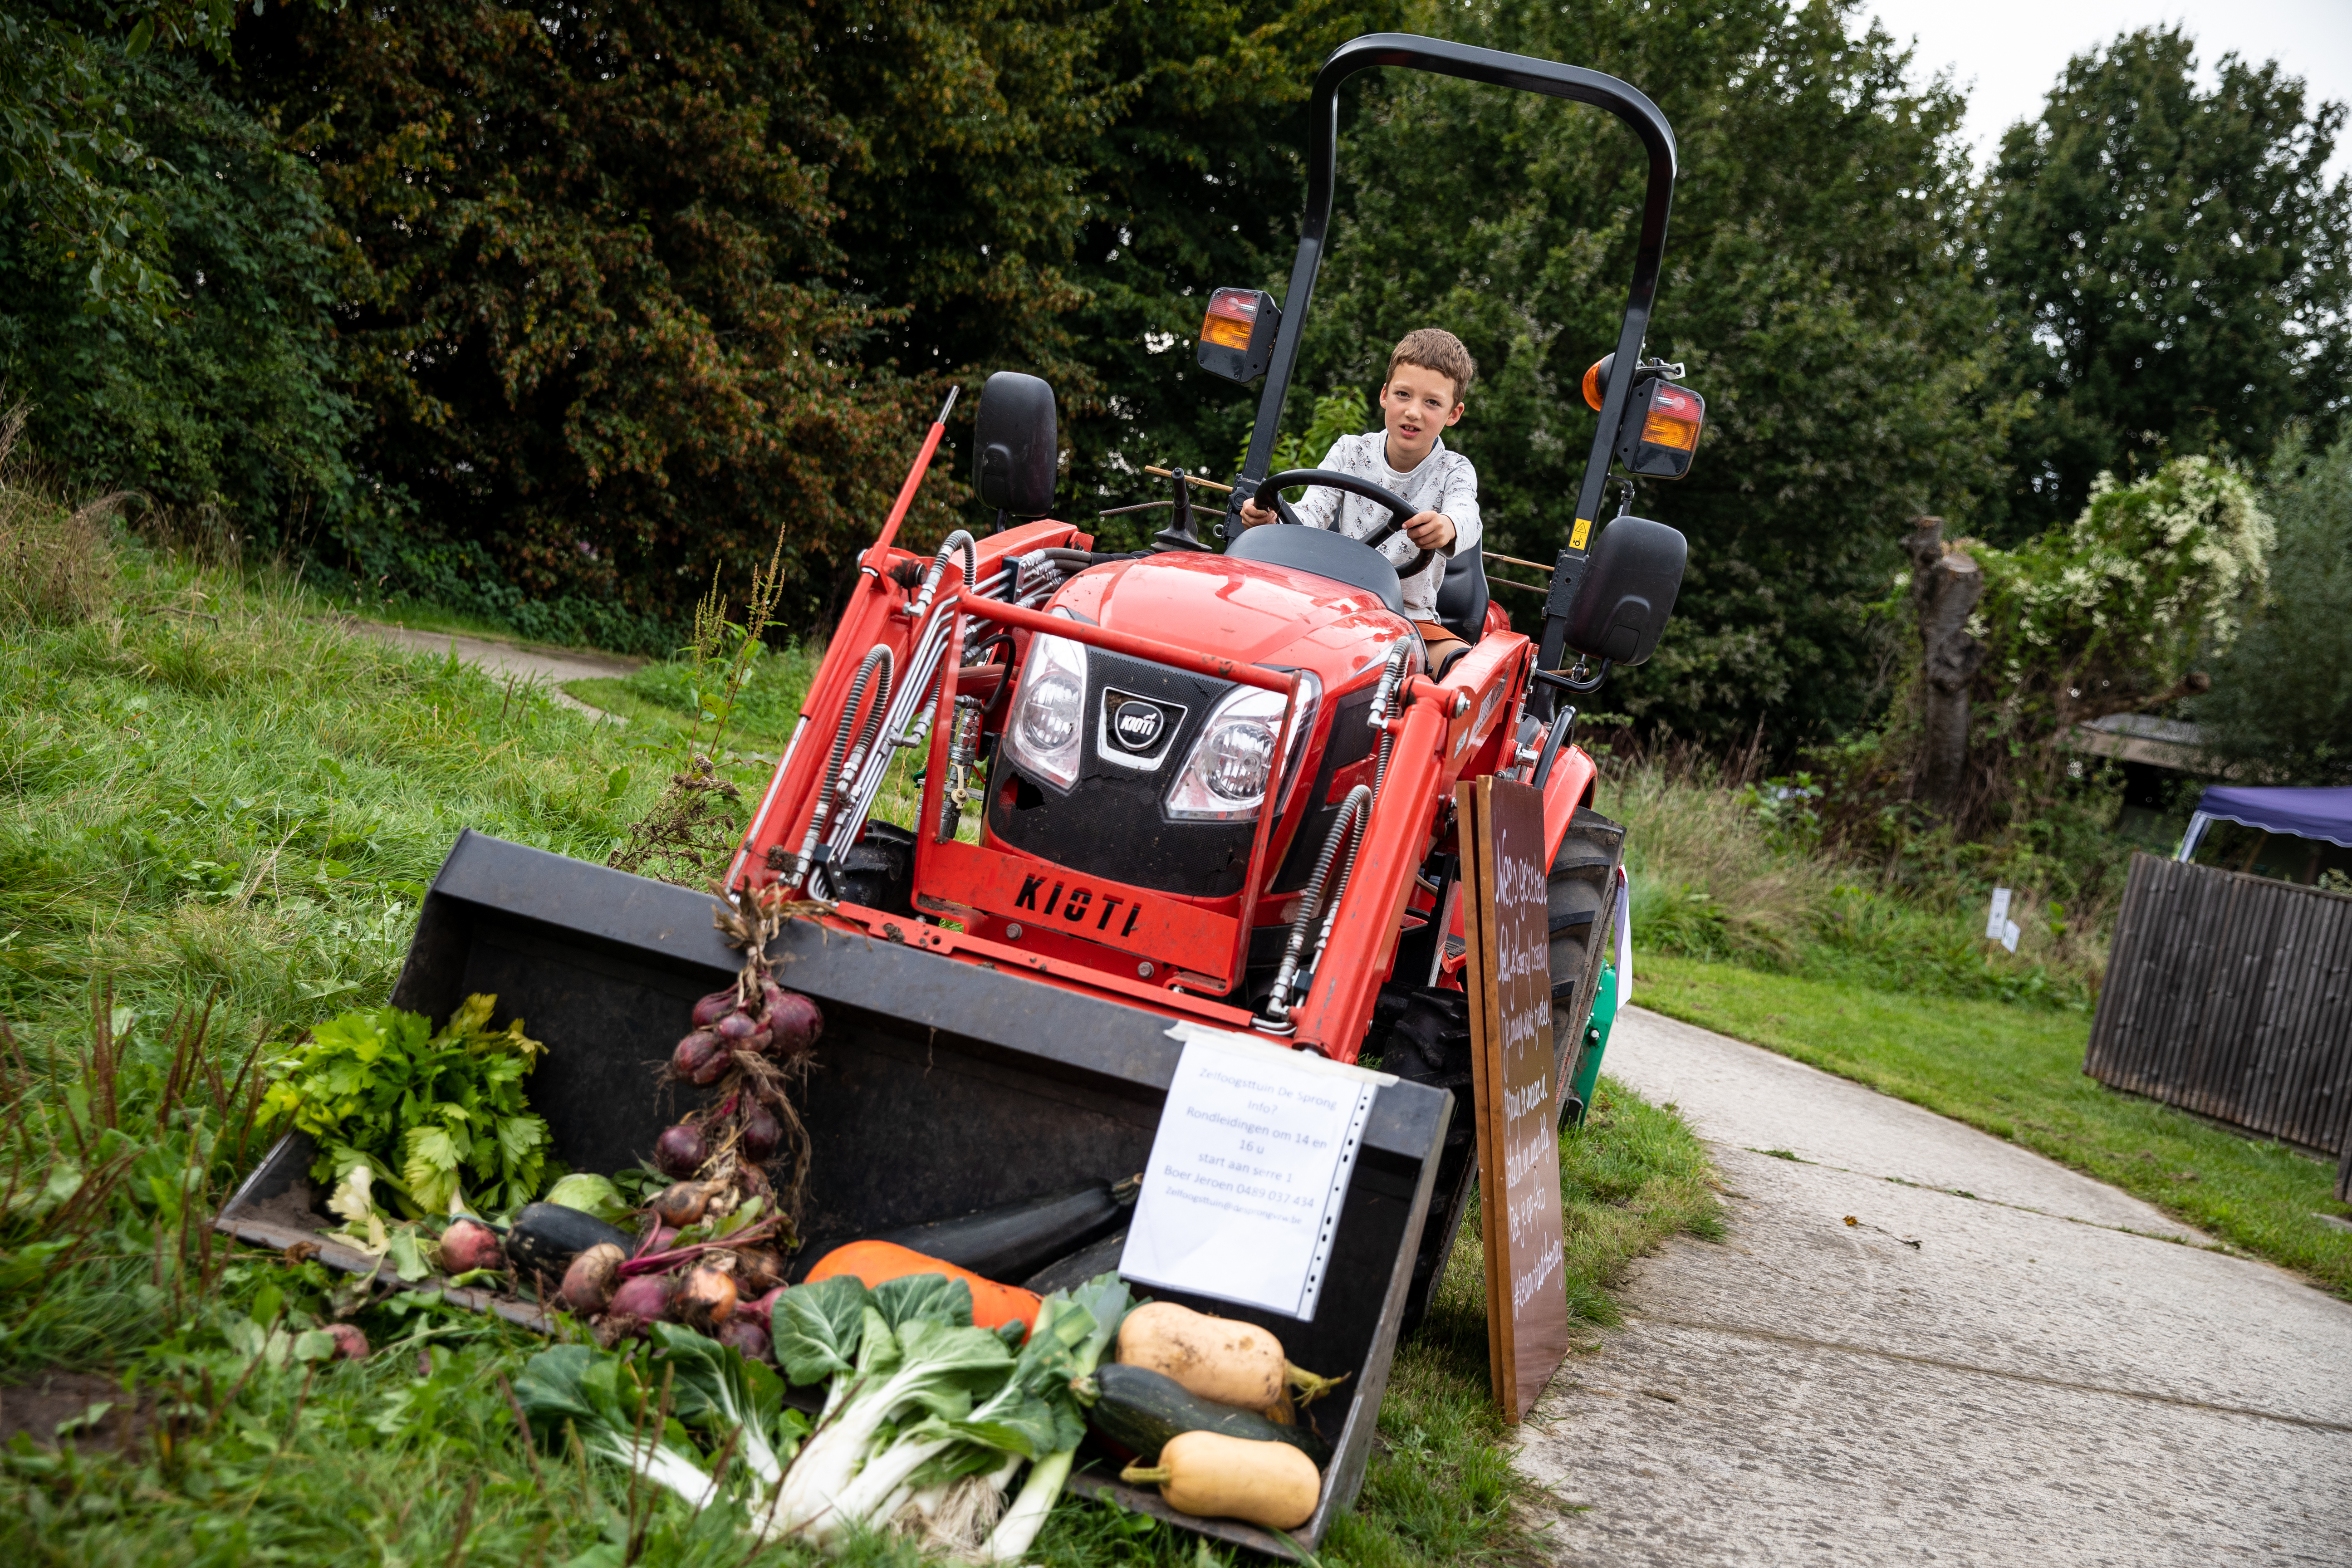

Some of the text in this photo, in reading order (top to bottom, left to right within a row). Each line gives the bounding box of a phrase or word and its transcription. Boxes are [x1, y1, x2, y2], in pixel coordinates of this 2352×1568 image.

[1119, 715, 1156, 735] KIOTI
[1014, 873, 1142, 937] KIOTI
[1510, 1013, 1524, 1060] mag
[1278, 1087, 1294, 1098] De
[1297, 1092, 1337, 1111] Sprong
[1540, 1066, 1548, 1100] in
[1186, 1106, 1327, 1148] Rondleidingen om 14 en
[1239, 1139, 1264, 1155] 16 u
[1523, 1147, 1530, 1174] en
[1198, 1153, 1225, 1167] start
[1228, 1161, 1250, 1173] aan
[1286, 1173, 1292, 1183] 1
[1164, 1164, 1192, 1181] Boer
[1194, 1173, 1234, 1191] Jeroen
[1268, 1191, 1291, 1203] 037
[1293, 1196, 1314, 1208] 434
[1527, 1194, 1533, 1233] op
[1534, 1170, 1545, 1230] foto
